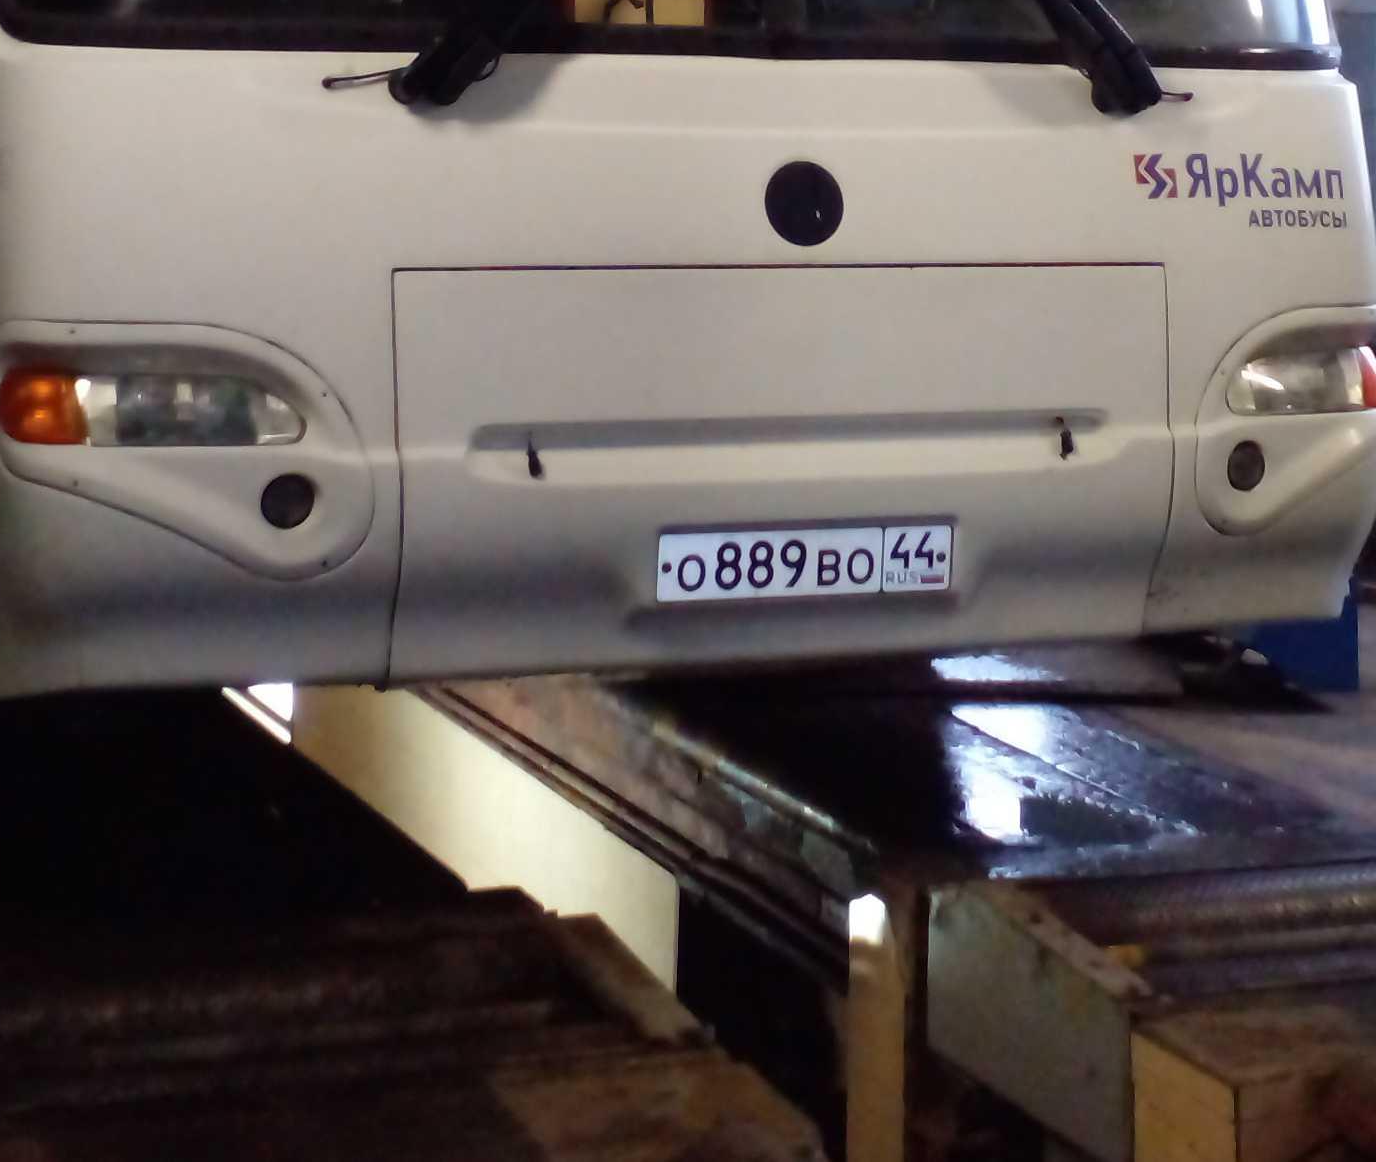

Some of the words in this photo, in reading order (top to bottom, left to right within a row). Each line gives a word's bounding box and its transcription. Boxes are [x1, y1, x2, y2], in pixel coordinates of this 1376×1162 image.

[1185, 152, 1345, 206] ЯрКамп
[1248, 209, 1348, 228] АВТОБУСЫ
[890, 531, 935, 569] 44
[885, 571, 918, 585] RUS
